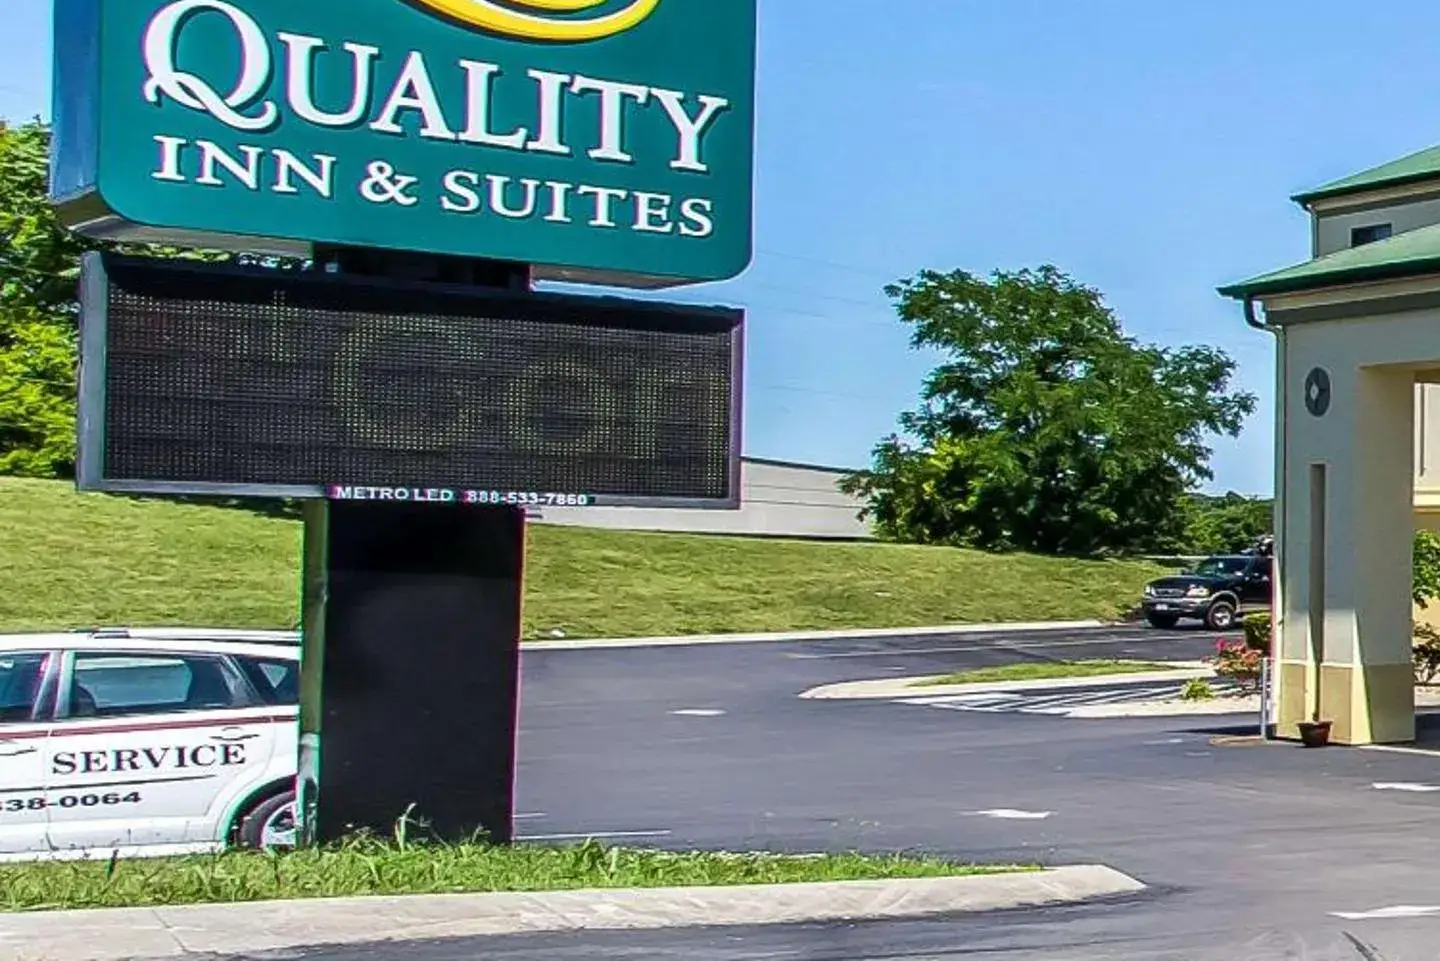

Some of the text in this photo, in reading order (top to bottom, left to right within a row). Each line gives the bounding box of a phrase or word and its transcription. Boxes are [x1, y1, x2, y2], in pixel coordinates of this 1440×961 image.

[153, 135, 714, 238] INN & SUITES
[334, 486, 410, 501] METRO
[413, 487, 455, 502] LED
[52, 743, 246, 775] SERVICE
